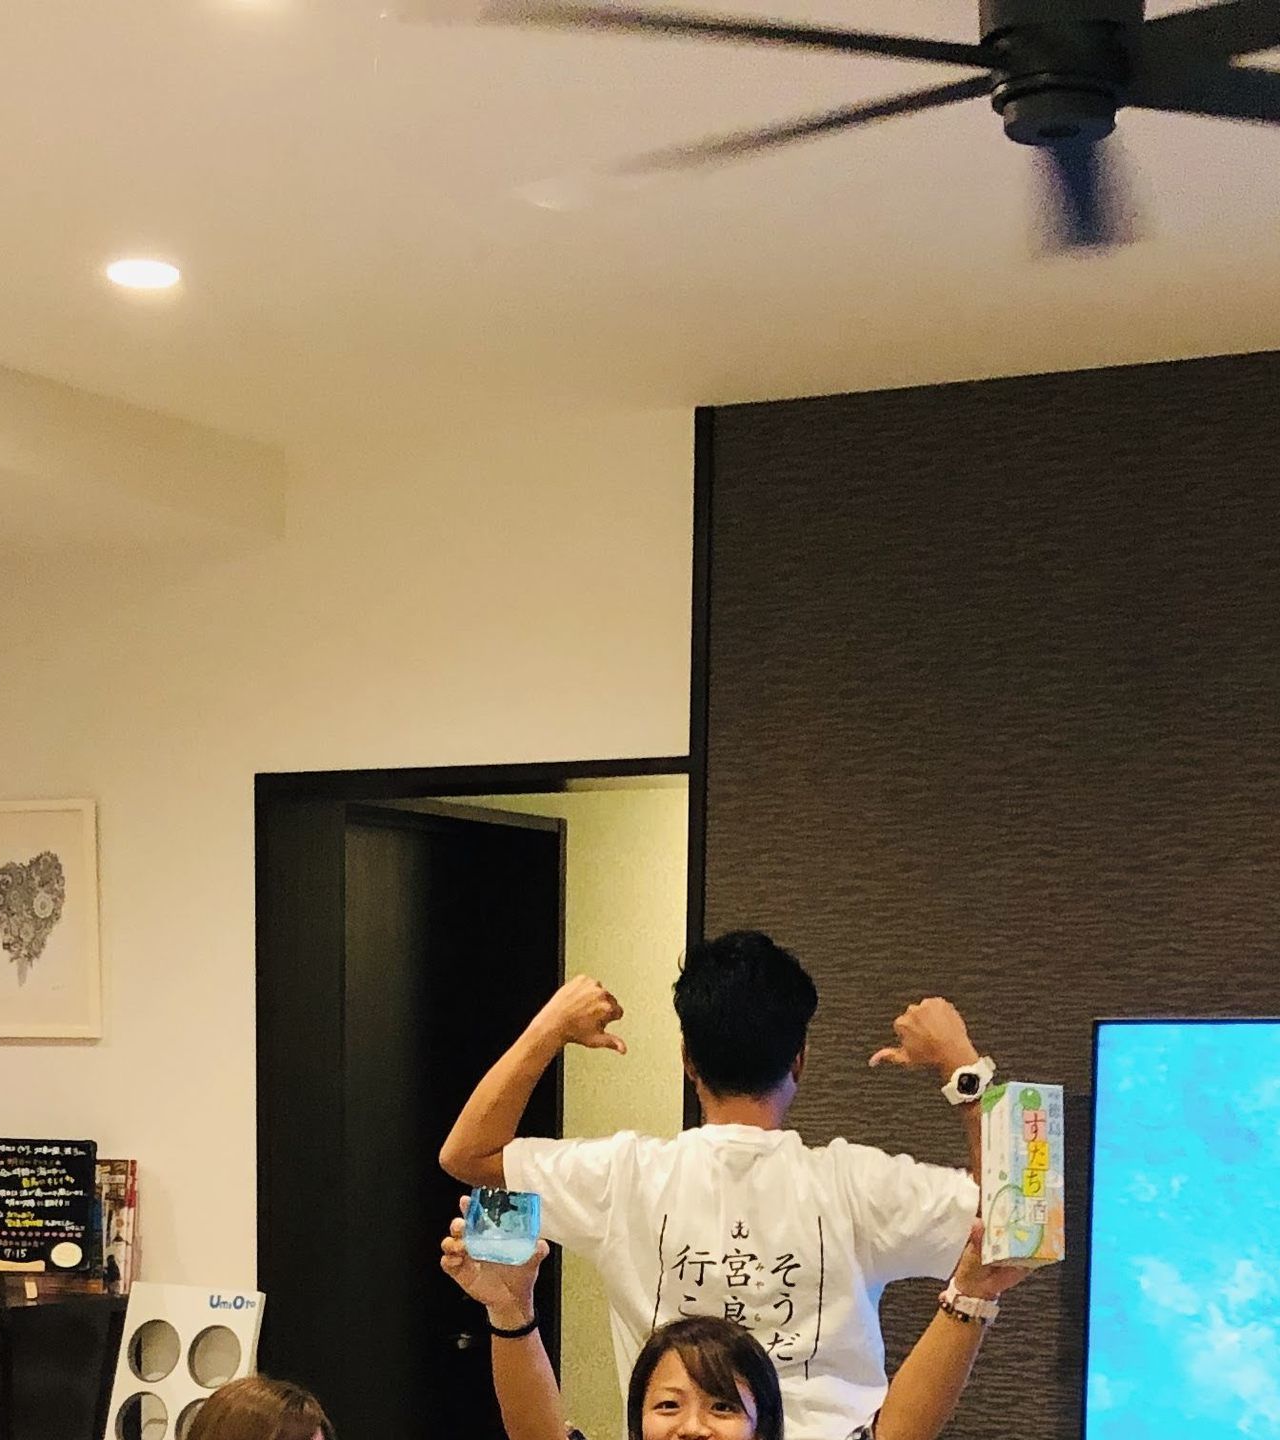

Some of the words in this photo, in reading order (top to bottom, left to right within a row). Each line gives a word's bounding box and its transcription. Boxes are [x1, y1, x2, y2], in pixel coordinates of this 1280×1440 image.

[209, 1294, 256, 1310] UmiOto
[767, 1253, 801, 1361] そうだ
